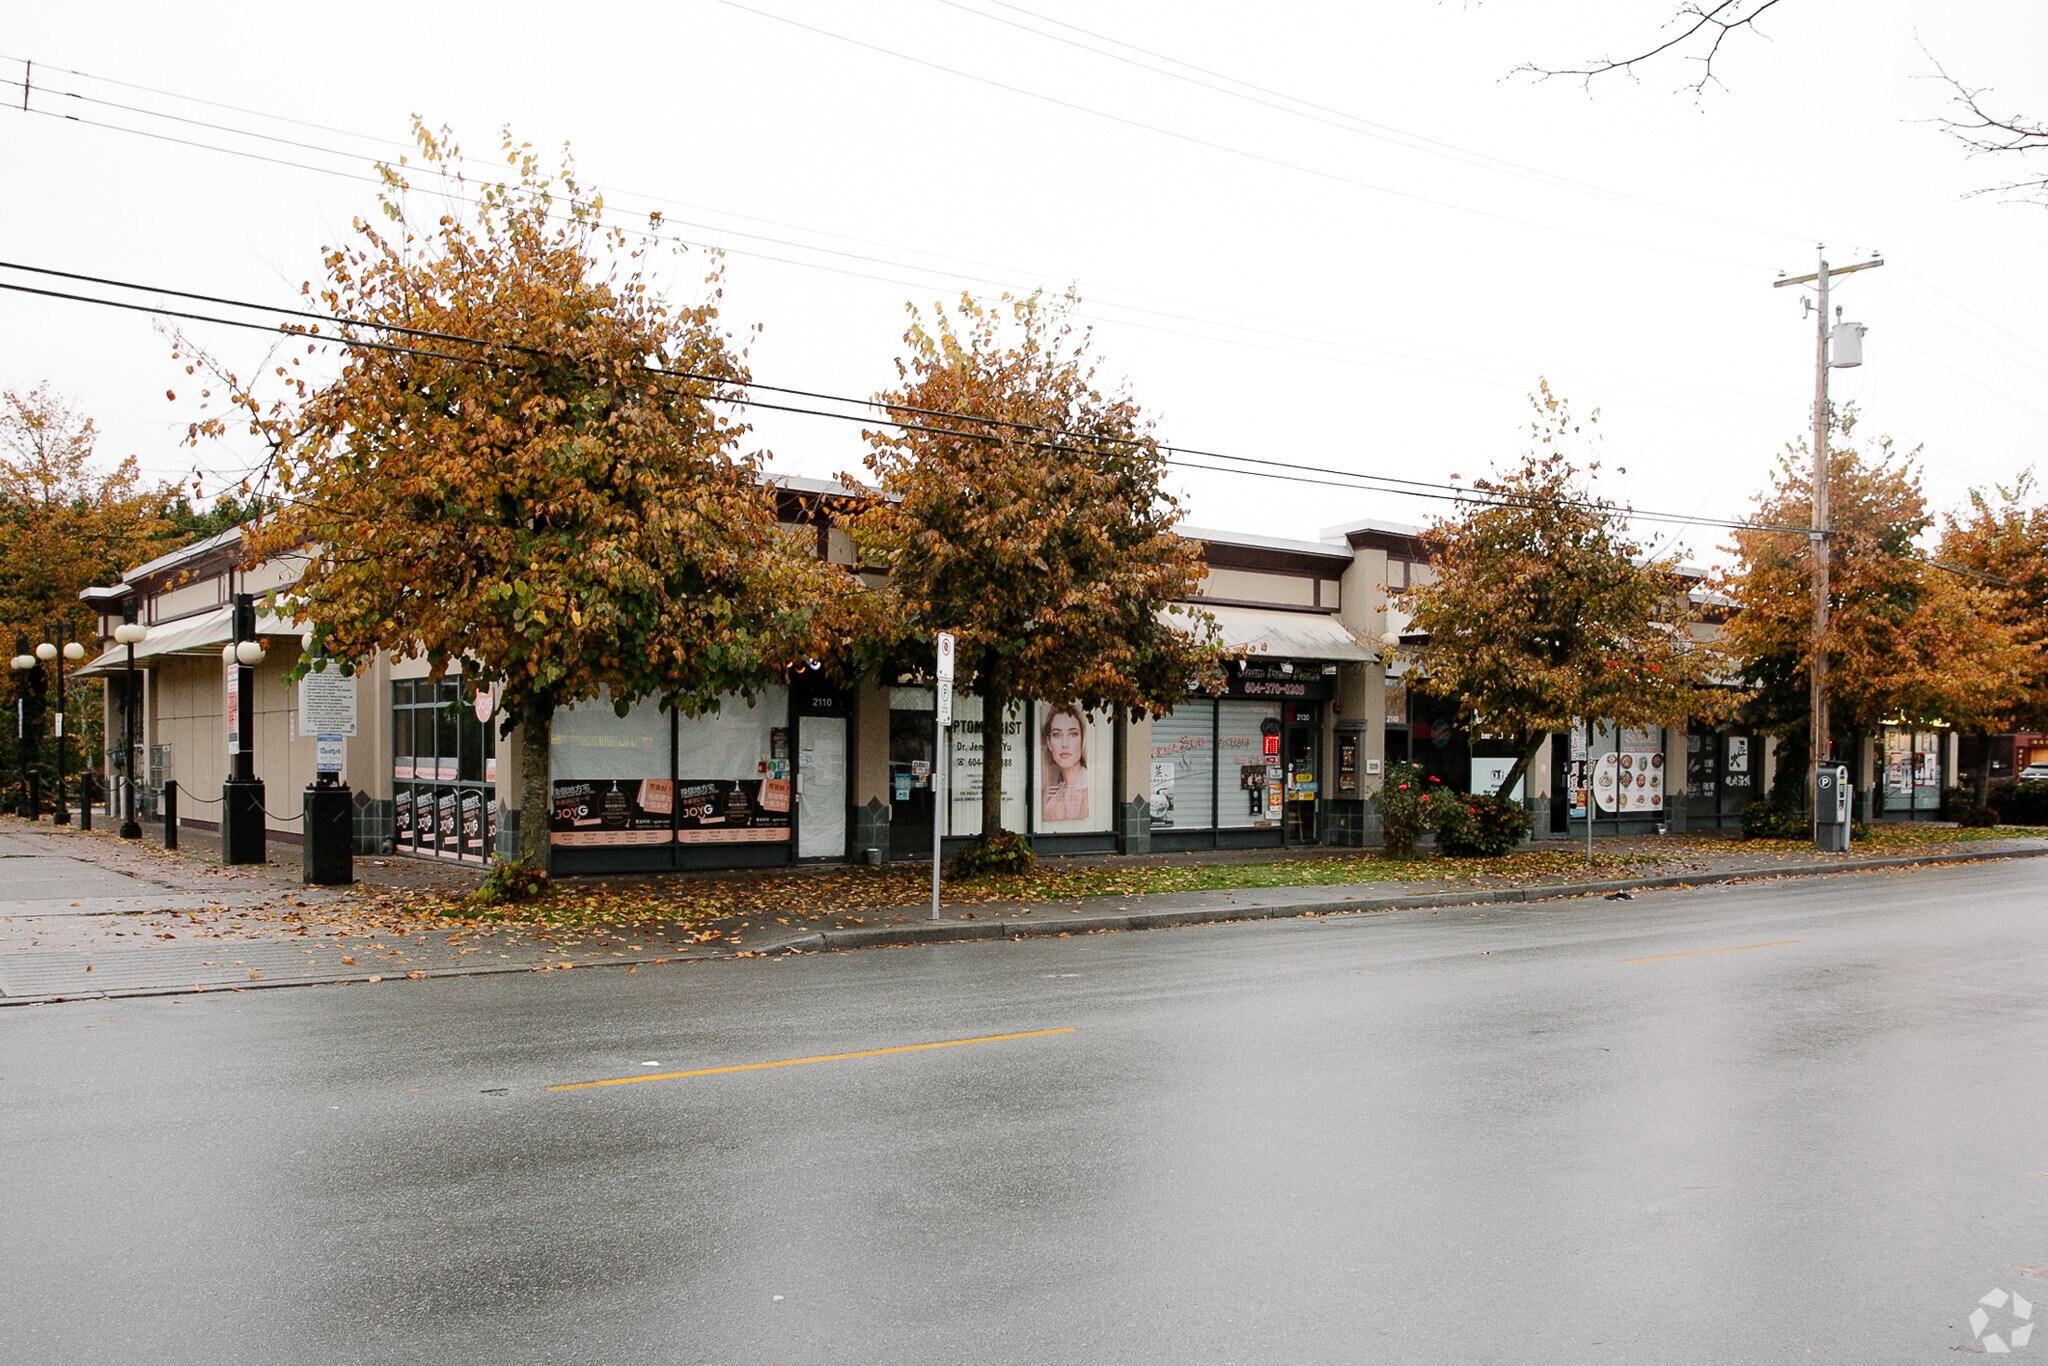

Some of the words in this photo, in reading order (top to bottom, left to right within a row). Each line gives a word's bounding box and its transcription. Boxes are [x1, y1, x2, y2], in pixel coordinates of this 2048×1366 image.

[813, 697, 833, 707] 2110
[956, 742, 968, 752] Dr.
[1002, 742, 1012, 752] Yu
[1821, 778, 1829, 787] P
[555, 805, 589, 820] JOYG
[683, 804, 713, 820] JOYG
